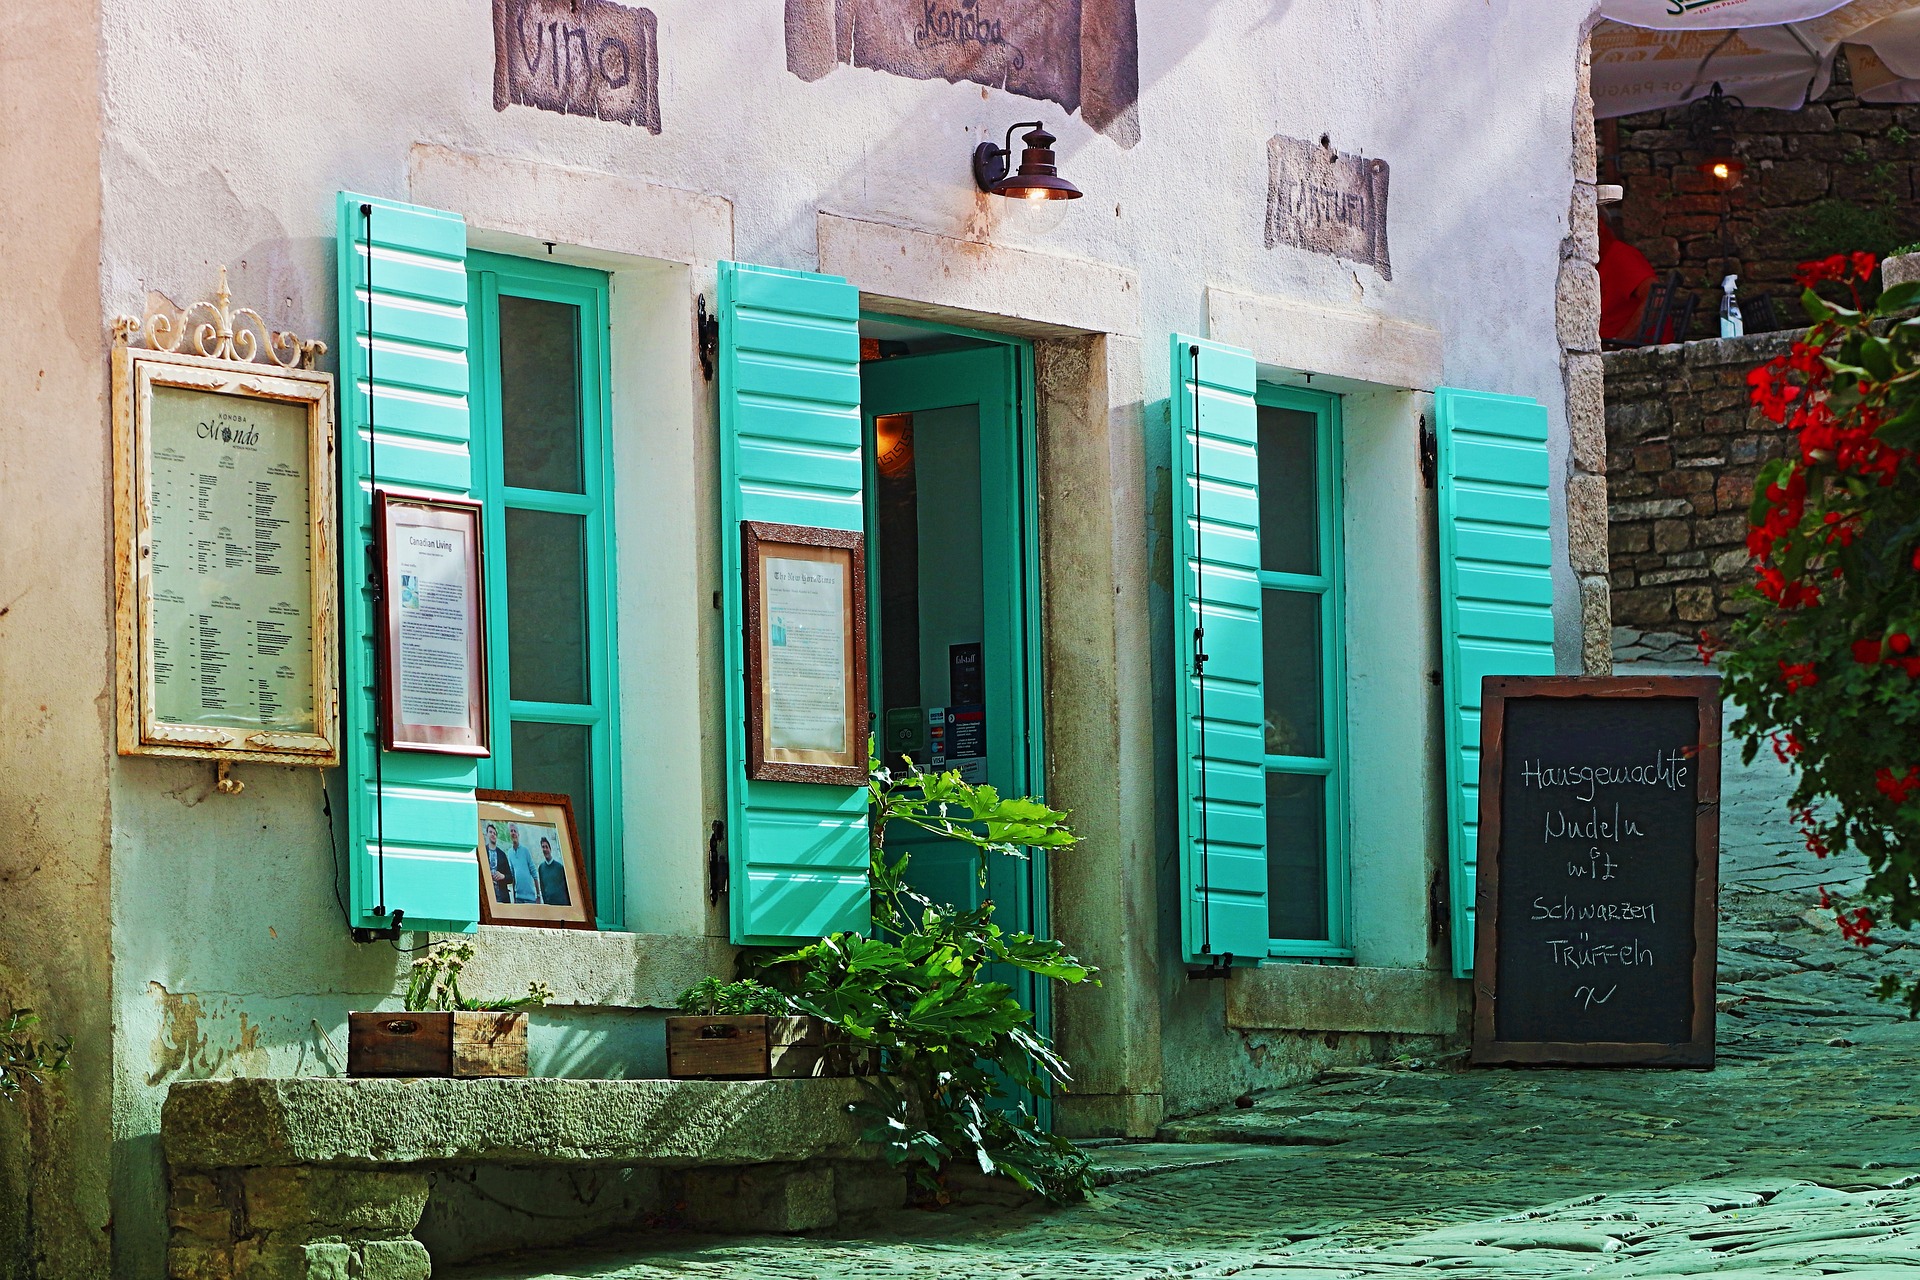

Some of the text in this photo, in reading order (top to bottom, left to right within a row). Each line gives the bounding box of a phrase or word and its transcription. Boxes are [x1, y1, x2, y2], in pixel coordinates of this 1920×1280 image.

[218, 413, 247, 423] KONOBA
[196, 420, 260, 446] Mondo
[409, 536, 452, 552] Canadian Living
[774, 571, 786, 582] The
[787, 572, 801, 582] New
[816, 574, 835, 584] Times
